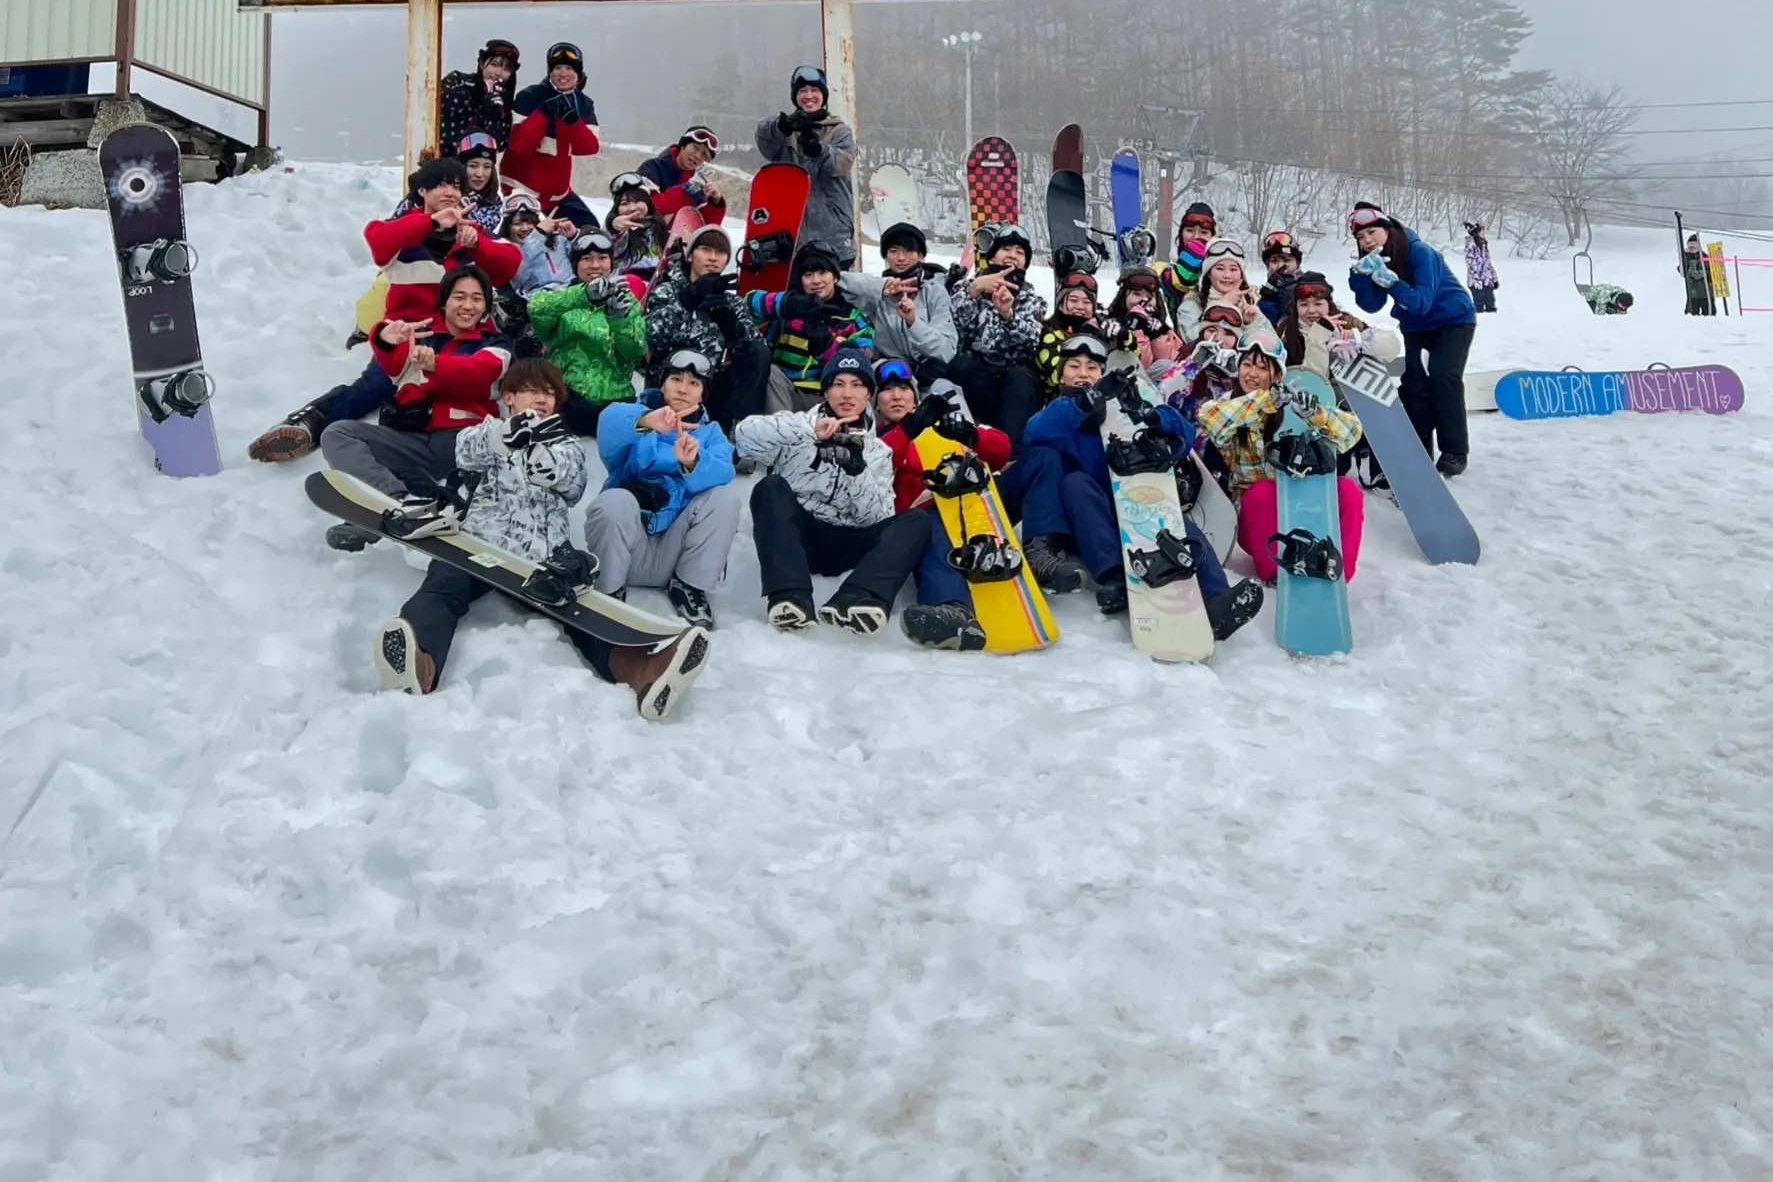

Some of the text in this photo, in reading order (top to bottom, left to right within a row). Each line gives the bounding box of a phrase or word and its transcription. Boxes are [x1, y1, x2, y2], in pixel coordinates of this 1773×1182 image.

[128, 285, 153, 297] LOOP
[1518, 370, 1720, 414] MODERN AMUSEMENT
